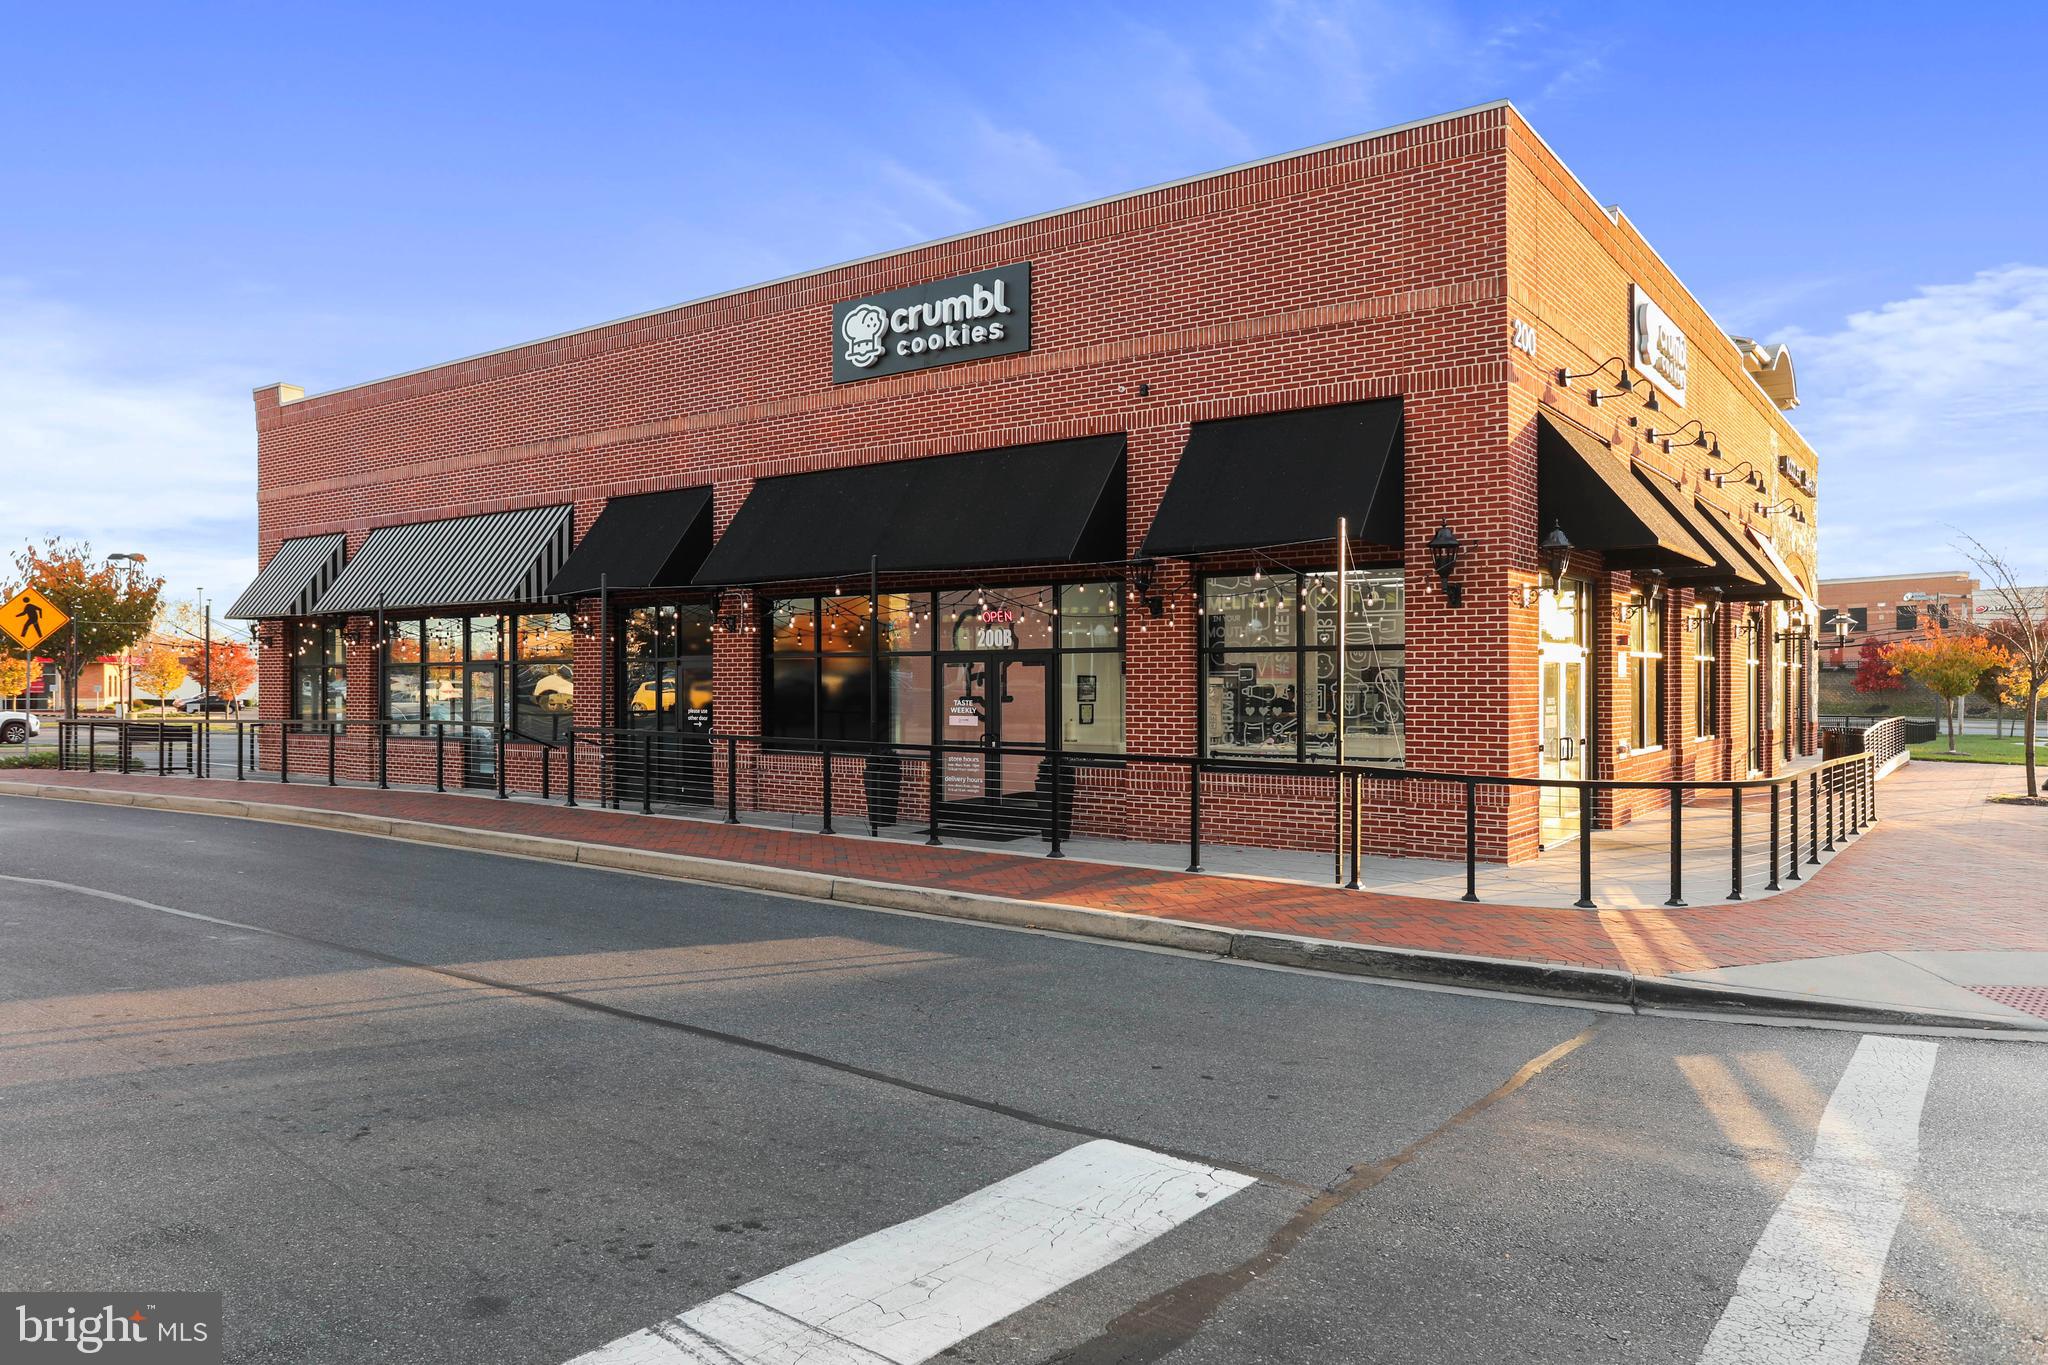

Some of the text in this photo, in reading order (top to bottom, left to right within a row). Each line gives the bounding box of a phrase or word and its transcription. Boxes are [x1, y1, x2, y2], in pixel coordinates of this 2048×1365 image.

[890, 279, 1011, 334] crumbl
[897, 322, 1004, 356] cookies
[1512, 319, 1537, 357] 200
[1208, 595, 1248, 610] MELT
[982, 610, 1013, 623] OPEN
[977, 629, 1012, 647] 200B
[1208, 627, 1248, 638] MOUTH
